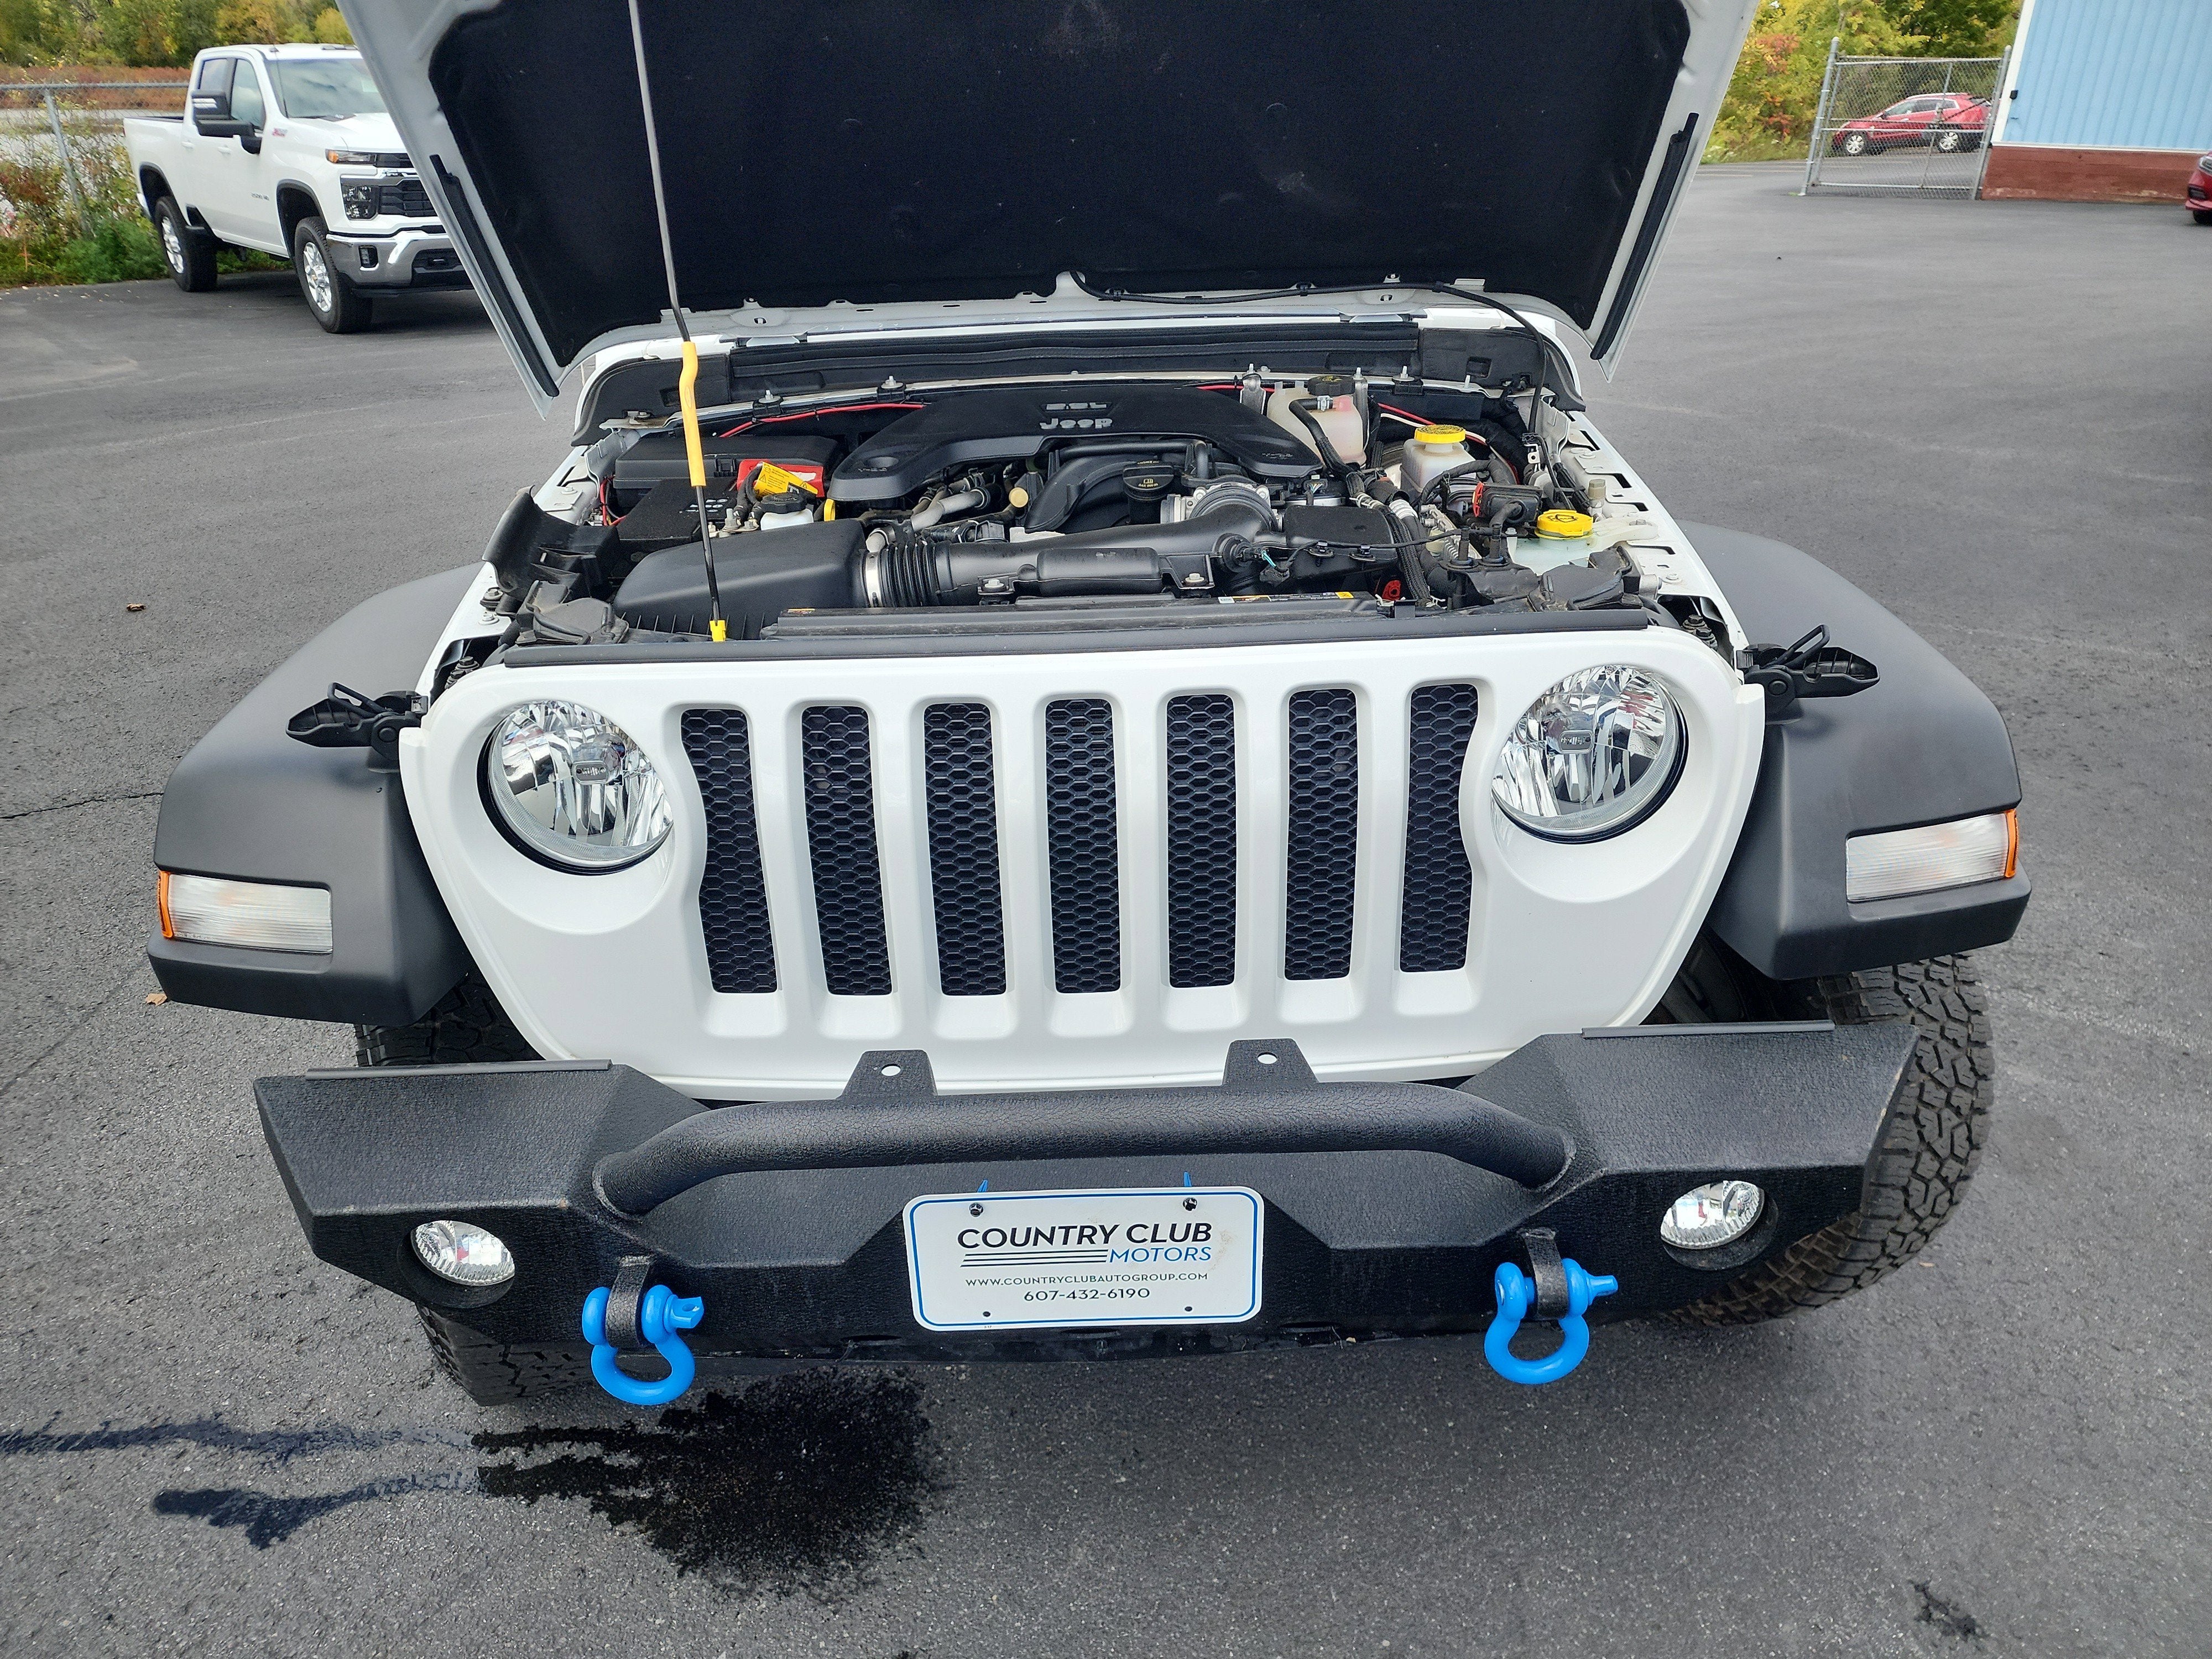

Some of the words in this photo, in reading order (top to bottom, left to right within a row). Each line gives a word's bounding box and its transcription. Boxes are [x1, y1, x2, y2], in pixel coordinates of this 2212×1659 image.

[957, 1224, 1120, 1248] COUNTRY
[1126, 1223, 1212, 1244] CLUB
[1109, 1246, 1212, 1262] MOTORS
[966, 1273, 1208, 1286] WWW.COUNTRYCLUBAUTOGROUP.COM
[1024, 1288, 1150, 1301] 607-432-6190
